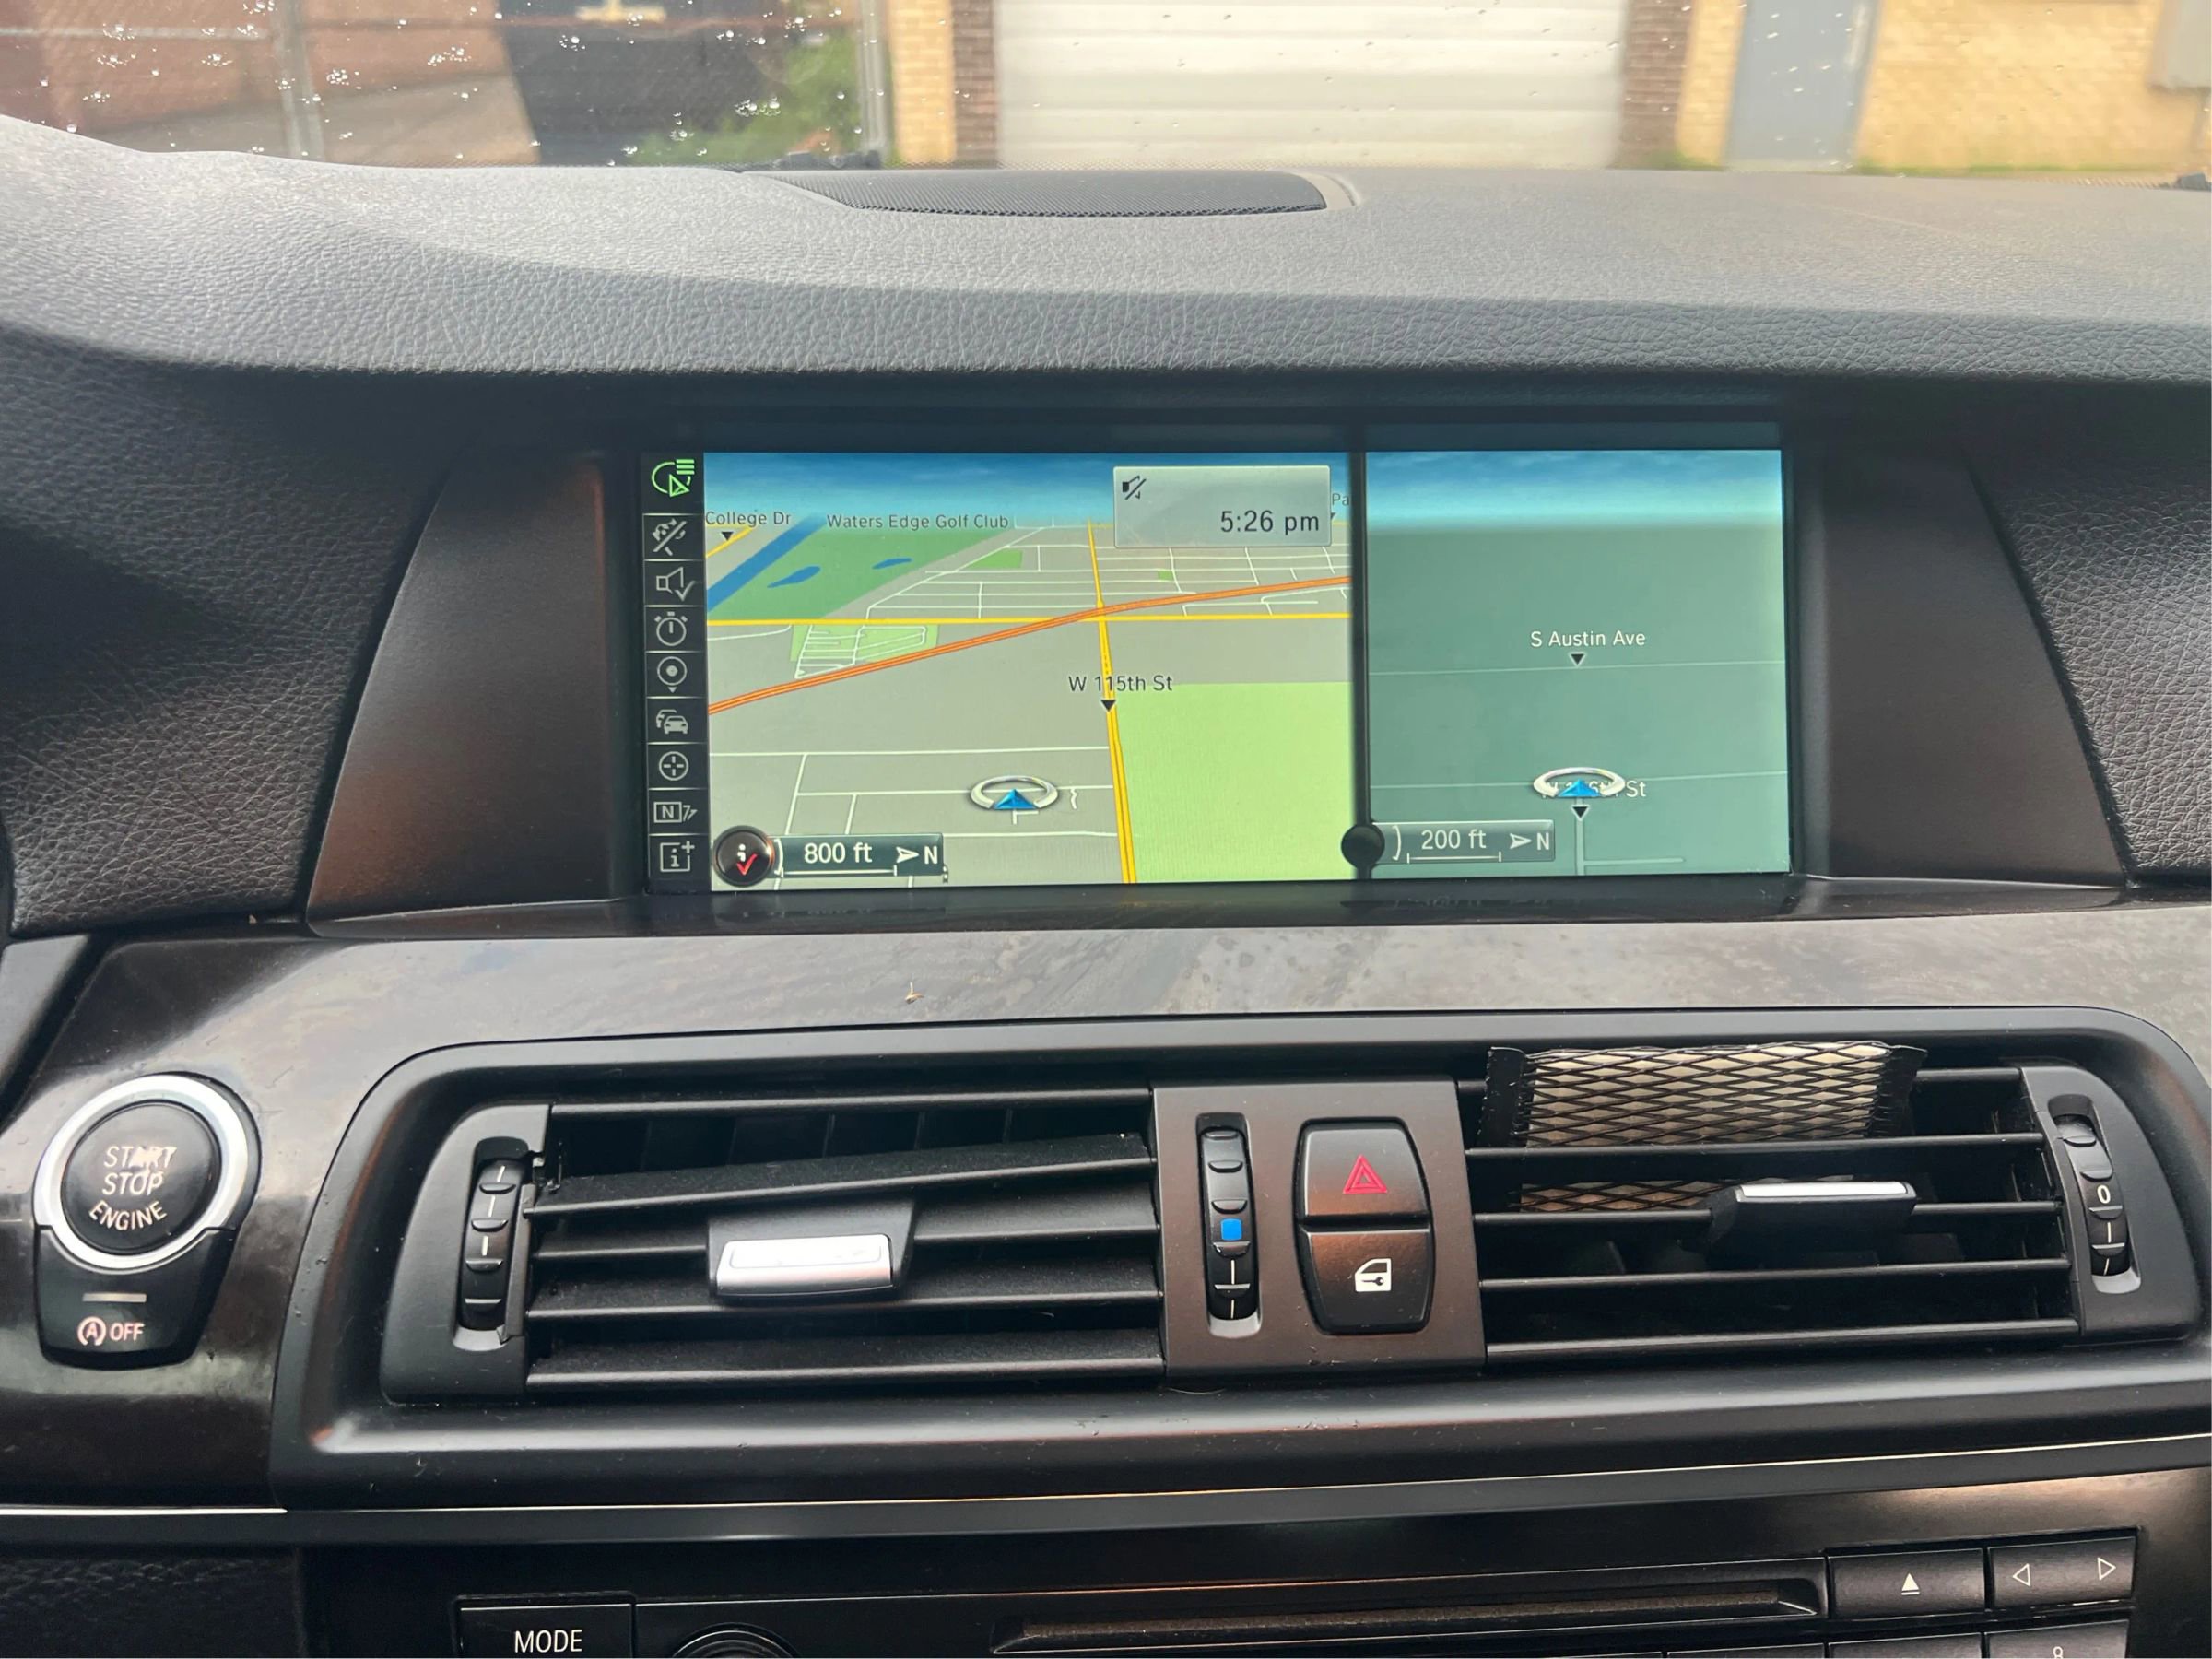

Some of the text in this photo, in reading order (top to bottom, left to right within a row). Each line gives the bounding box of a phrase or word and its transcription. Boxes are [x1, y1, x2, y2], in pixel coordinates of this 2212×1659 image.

[705, 511, 791, 527] College Dr
[827, 513, 1009, 532] Waters Edge Golf Club
[1220, 510, 1321, 536] 5:26 pm
[1530, 630, 1646, 647] S Austin Ave
[1068, 675, 1173, 692] W 115th St
[1626, 781, 1646, 797] St
[1421, 829, 1550, 851] 200 ft N
[804, 842, 938, 865] 800 ft N
[103, 1146, 177, 1168] START
[101, 1171, 165, 1196] STOP
[88, 1200, 168, 1231] ENGINE
[110, 1322, 146, 1341] OFF
[513, 1630, 583, 1653] MODE
